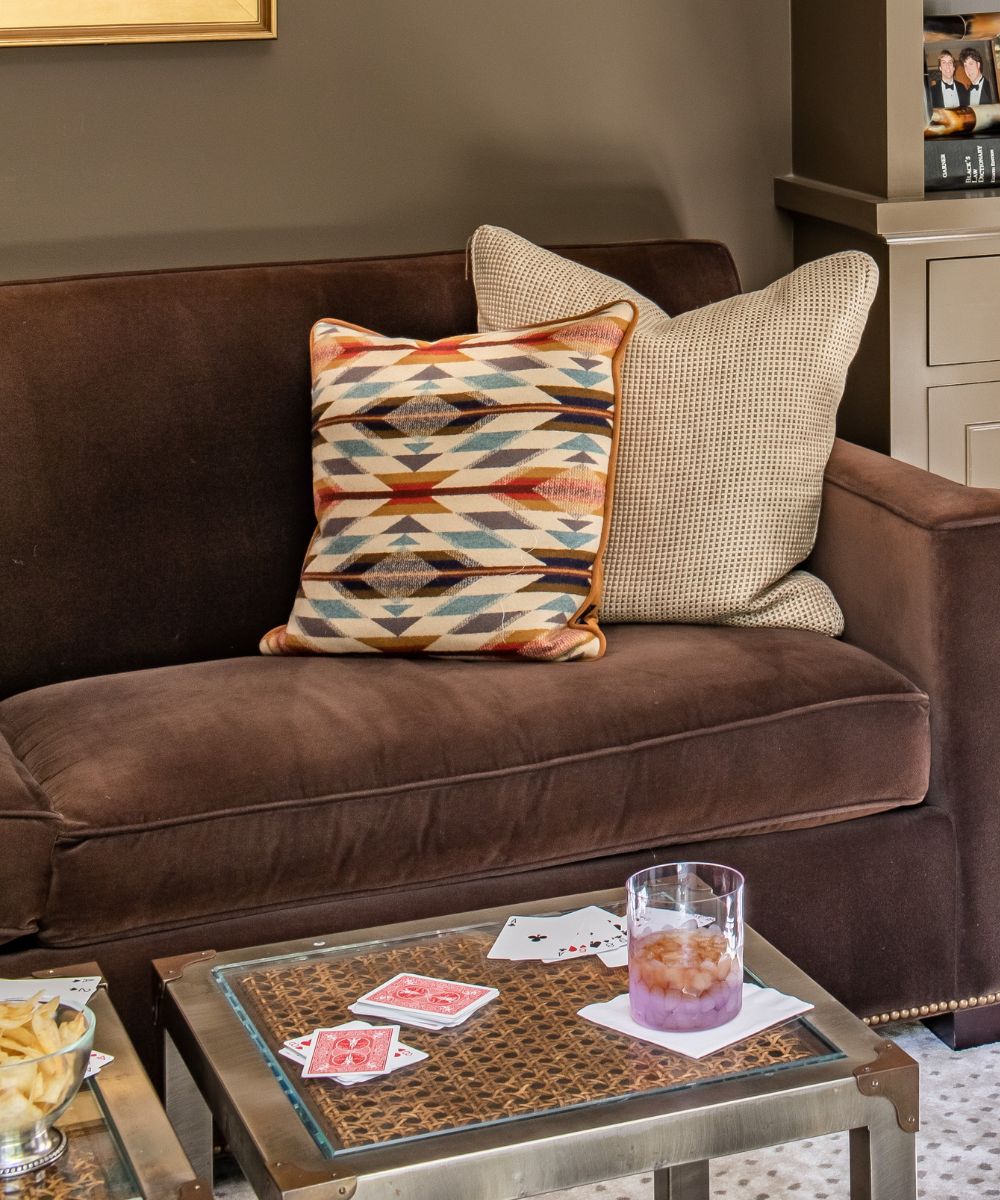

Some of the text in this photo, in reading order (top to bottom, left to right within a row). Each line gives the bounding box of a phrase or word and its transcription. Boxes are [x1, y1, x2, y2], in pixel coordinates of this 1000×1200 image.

[940, 153, 948, 179] GARNER
[964, 155, 972, 184] BLACK'S
[976, 145, 985, 183] DICTIONARY
